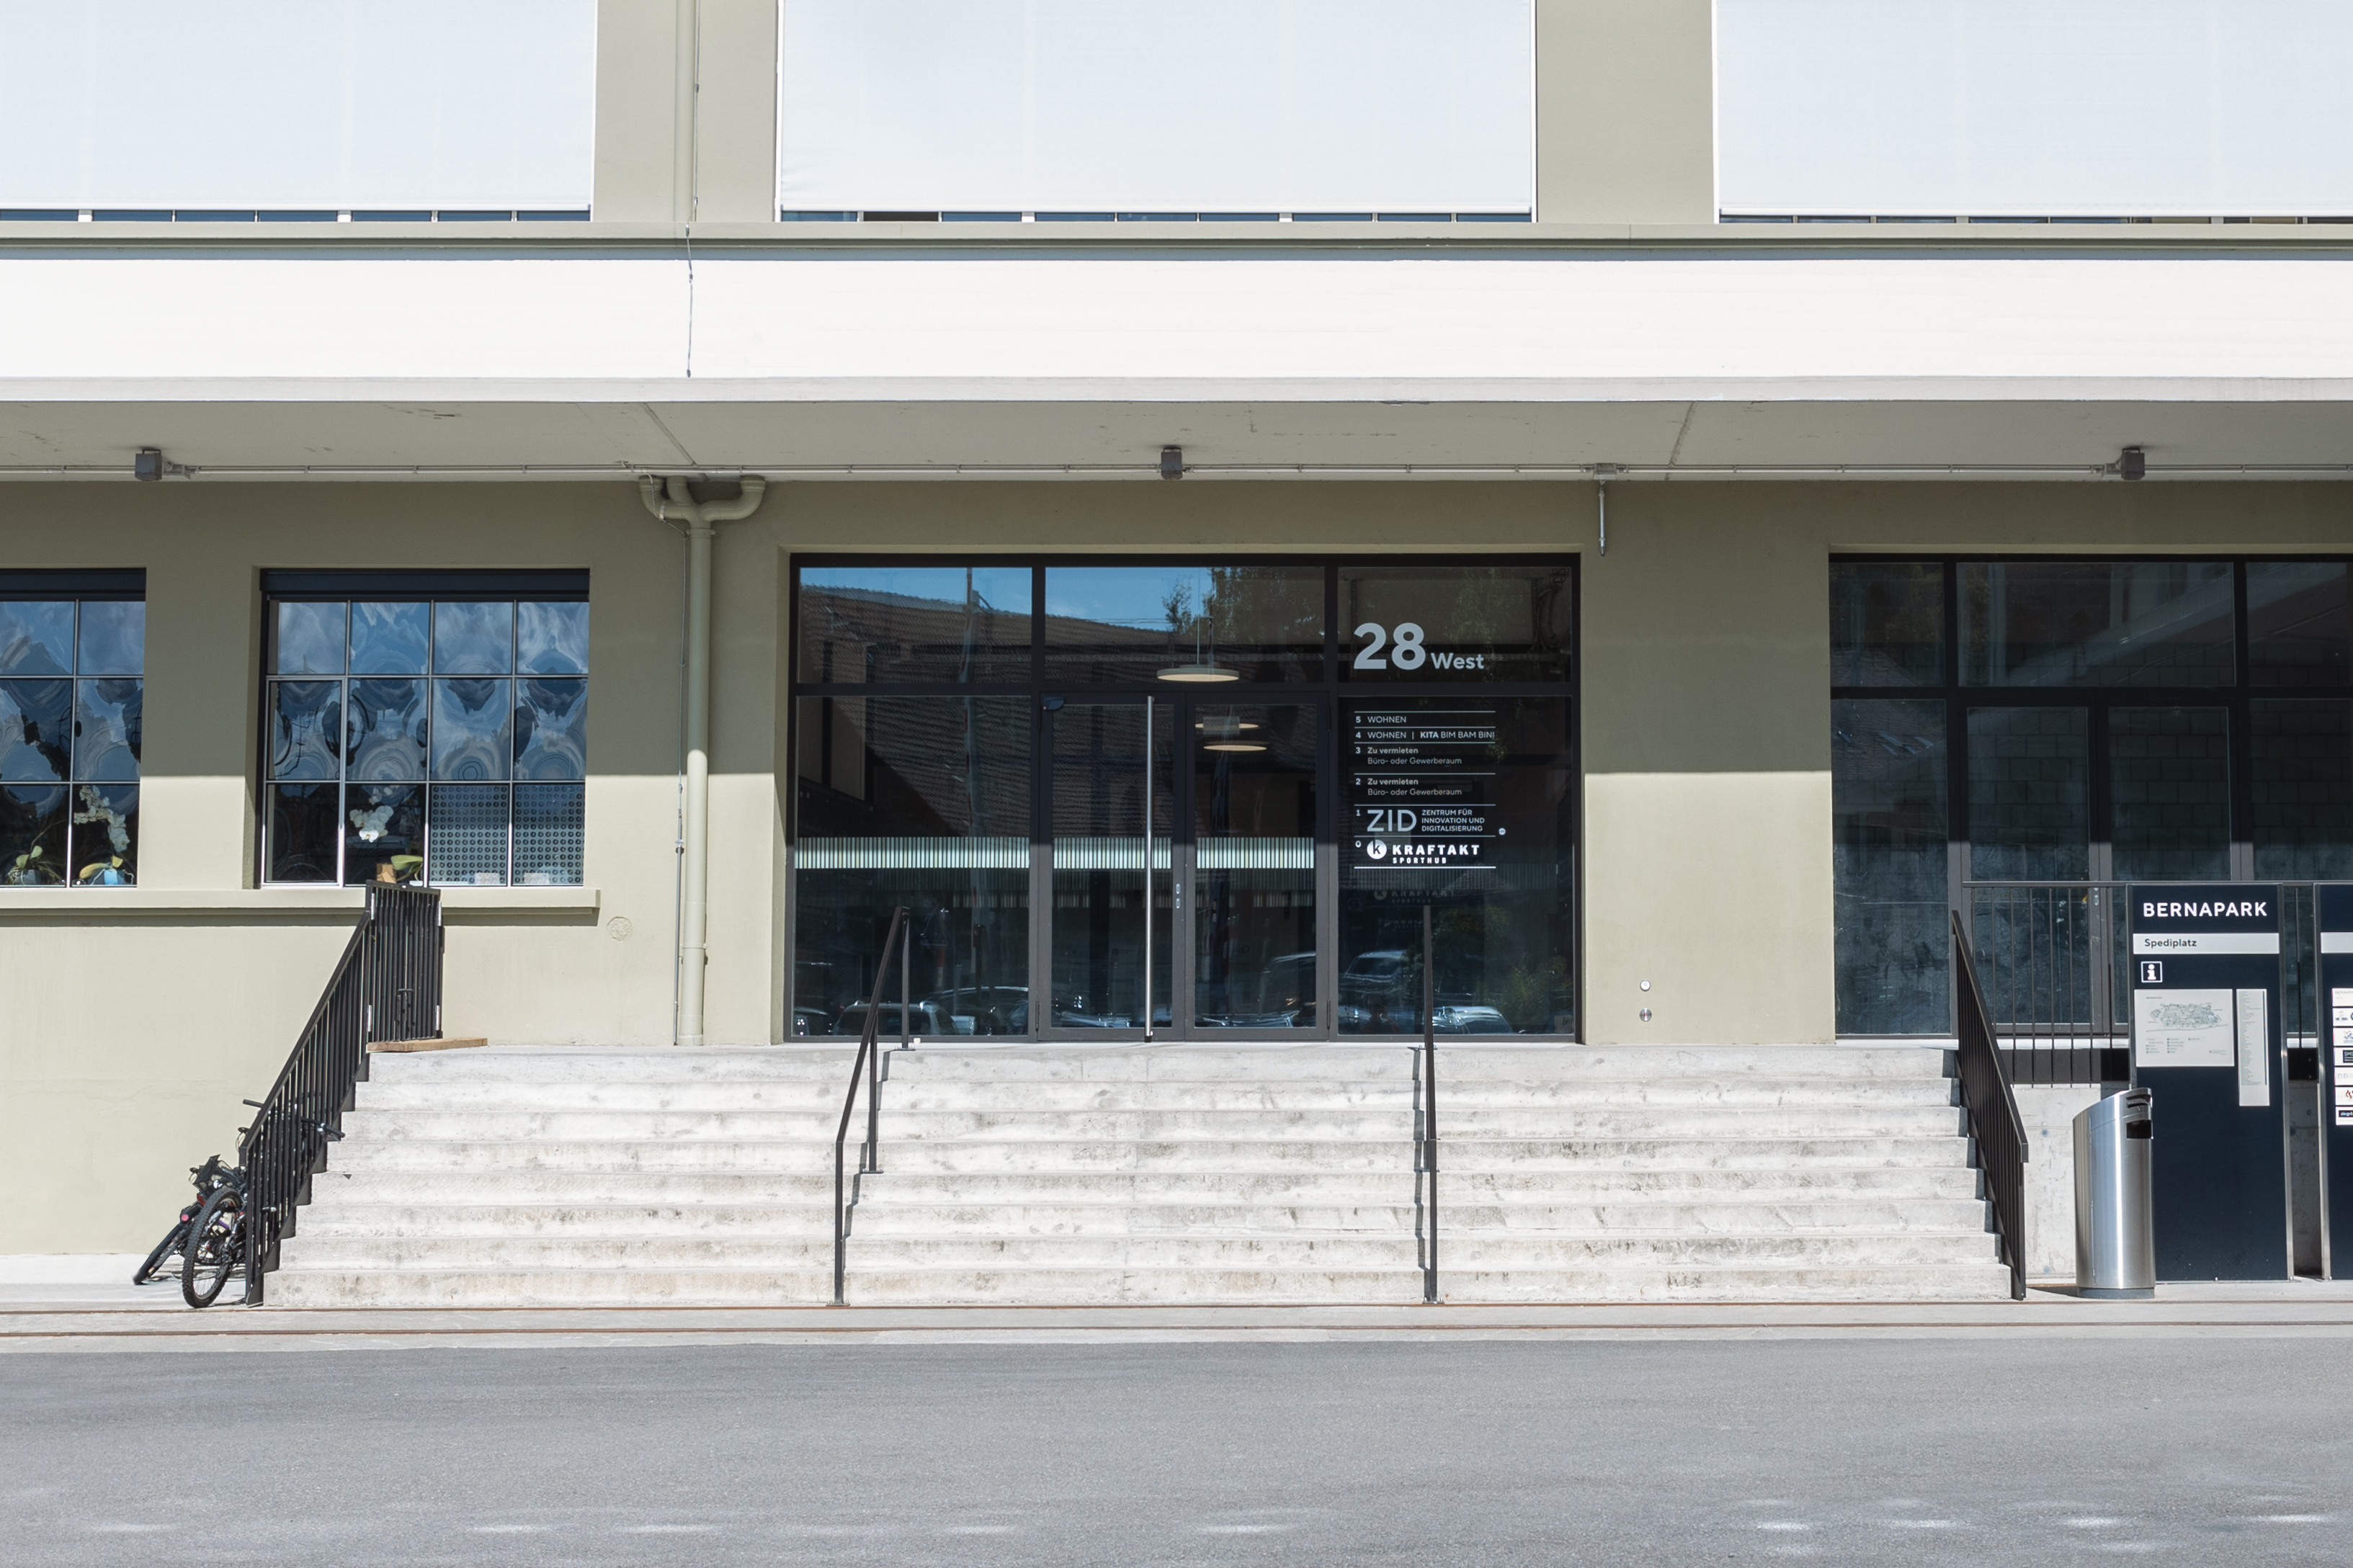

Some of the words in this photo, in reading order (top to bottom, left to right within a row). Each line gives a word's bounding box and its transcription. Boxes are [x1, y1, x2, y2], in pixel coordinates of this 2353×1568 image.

[1354, 622, 1426, 670] 28
[1431, 653, 1485, 669] West
[1367, 810, 1417, 832] ZID
[1392, 844, 1480, 855] KRAFTAKT
[2143, 902, 2267, 918] BERNAPARK
[2144, 938, 2197, 949] Spediplatz
